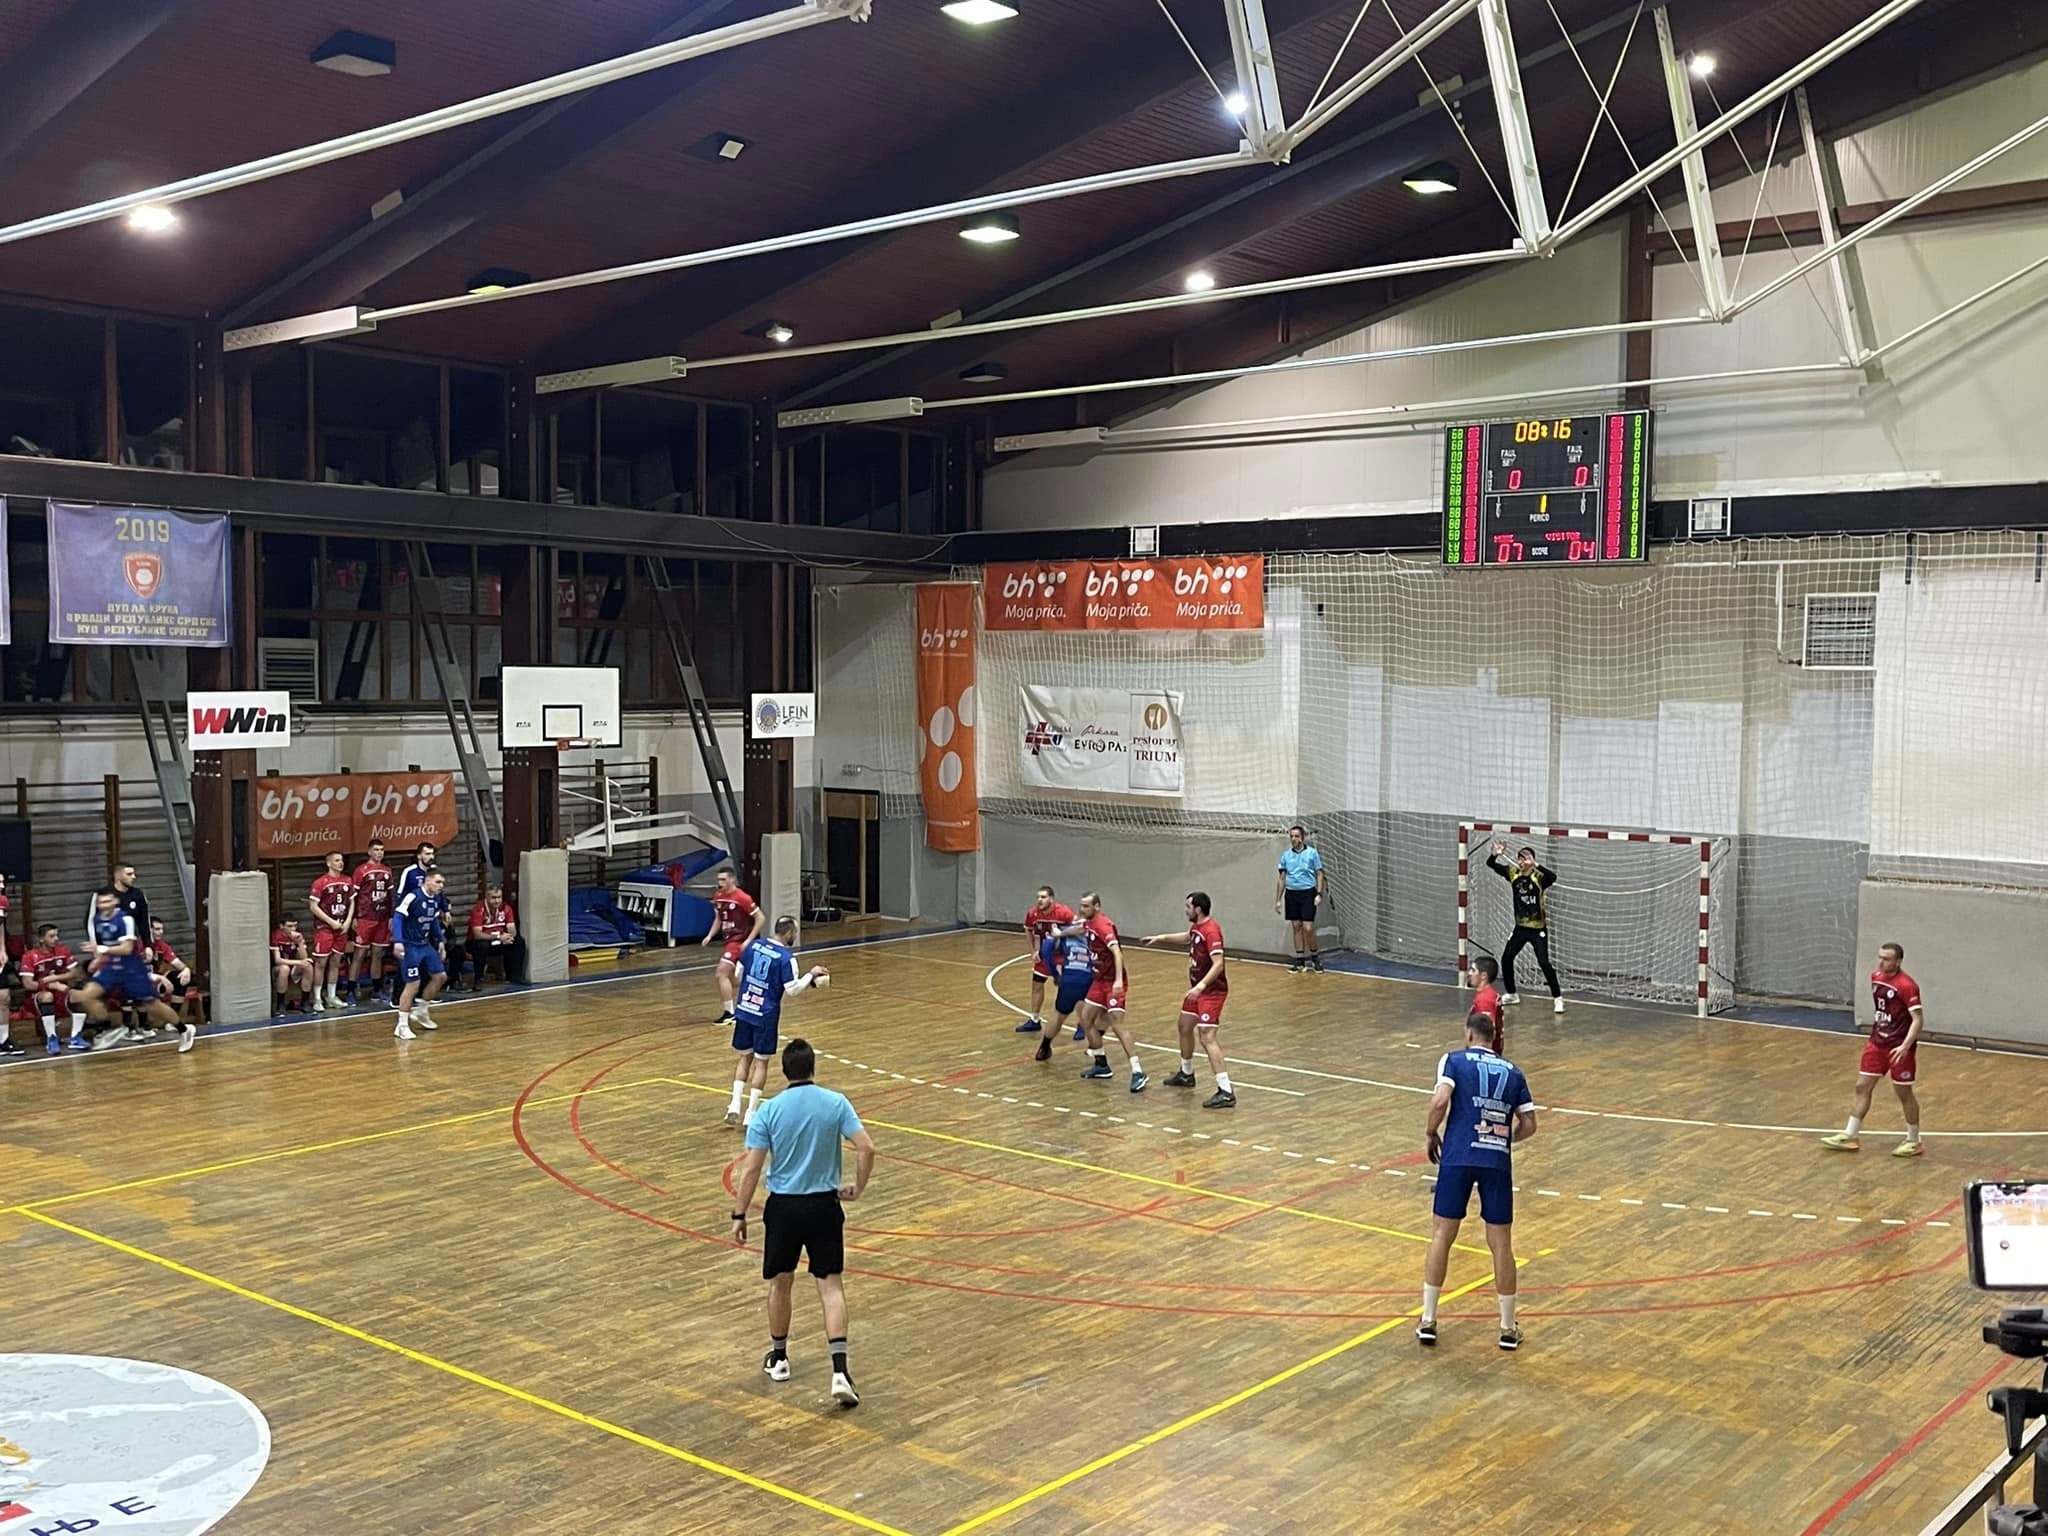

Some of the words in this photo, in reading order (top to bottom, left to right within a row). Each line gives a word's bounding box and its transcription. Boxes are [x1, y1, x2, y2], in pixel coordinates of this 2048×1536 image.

[1515, 419, 1572, 442] 08:16
[1509, 469, 1522, 490] 0
[1574, 466, 1588, 487] 0
[115, 517, 169, 543] 2019
[1498, 542, 1523, 562] 07
[1568, 541, 1595, 561] 04
[1003, 572, 1035, 598] bh
[1085, 569, 1119, 597] bh
[1174, 566, 1209, 595] bh
[1005, 604, 1034, 620] Moja
[1086, 602, 1117, 619] Moja
[1176, 602, 1207, 620] Moja
[193, 707, 286, 734] WWin
[1134, 750, 1176, 762] TRIUM
[261, 789, 304, 820] bh
[361, 785, 403, 816] bh
[272, 829, 302, 845] Moja
[371, 824, 402, 840] Moja
[750, 950, 772, 980] 10
[1477, 1062, 1509, 1099] 17
